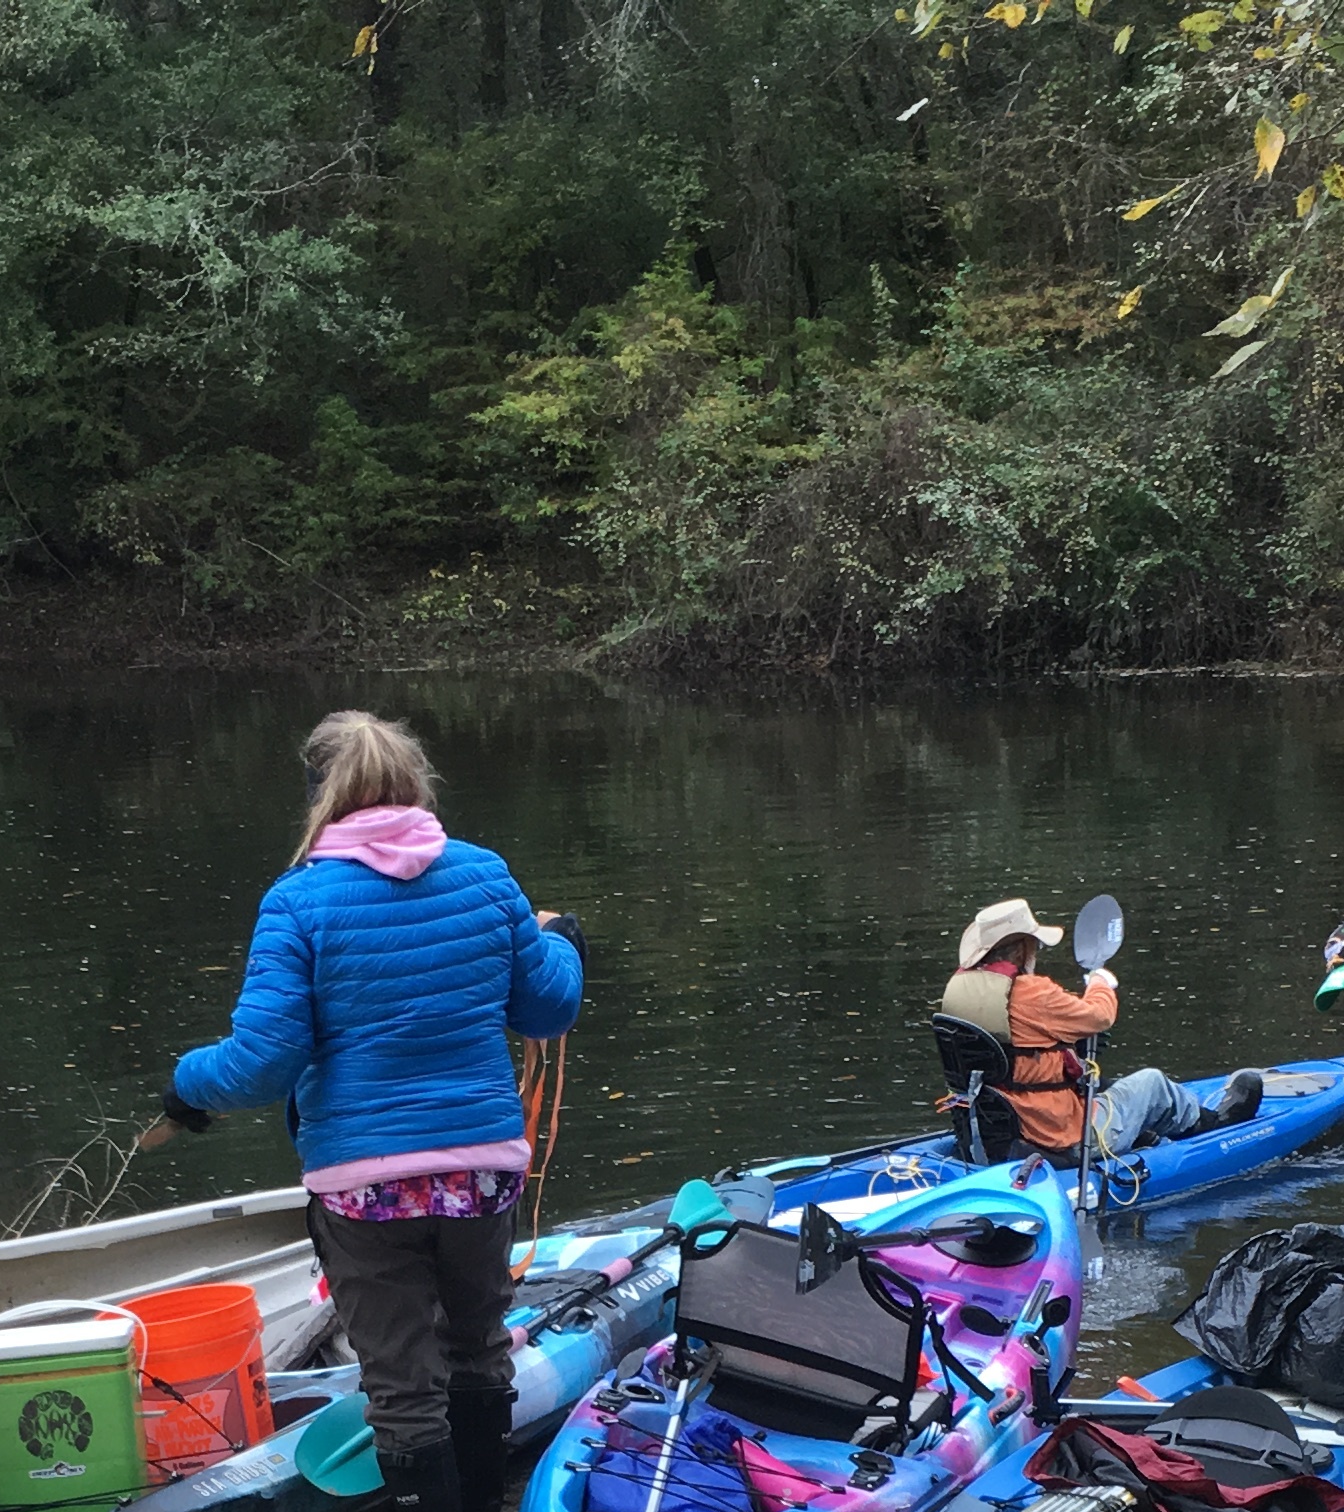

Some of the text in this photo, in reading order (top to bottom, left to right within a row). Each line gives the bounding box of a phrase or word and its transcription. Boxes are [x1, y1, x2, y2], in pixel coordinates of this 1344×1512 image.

[635, 1269, 671, 1292] VIBE
[192, 1457, 276, 1497] SEA GHOST
